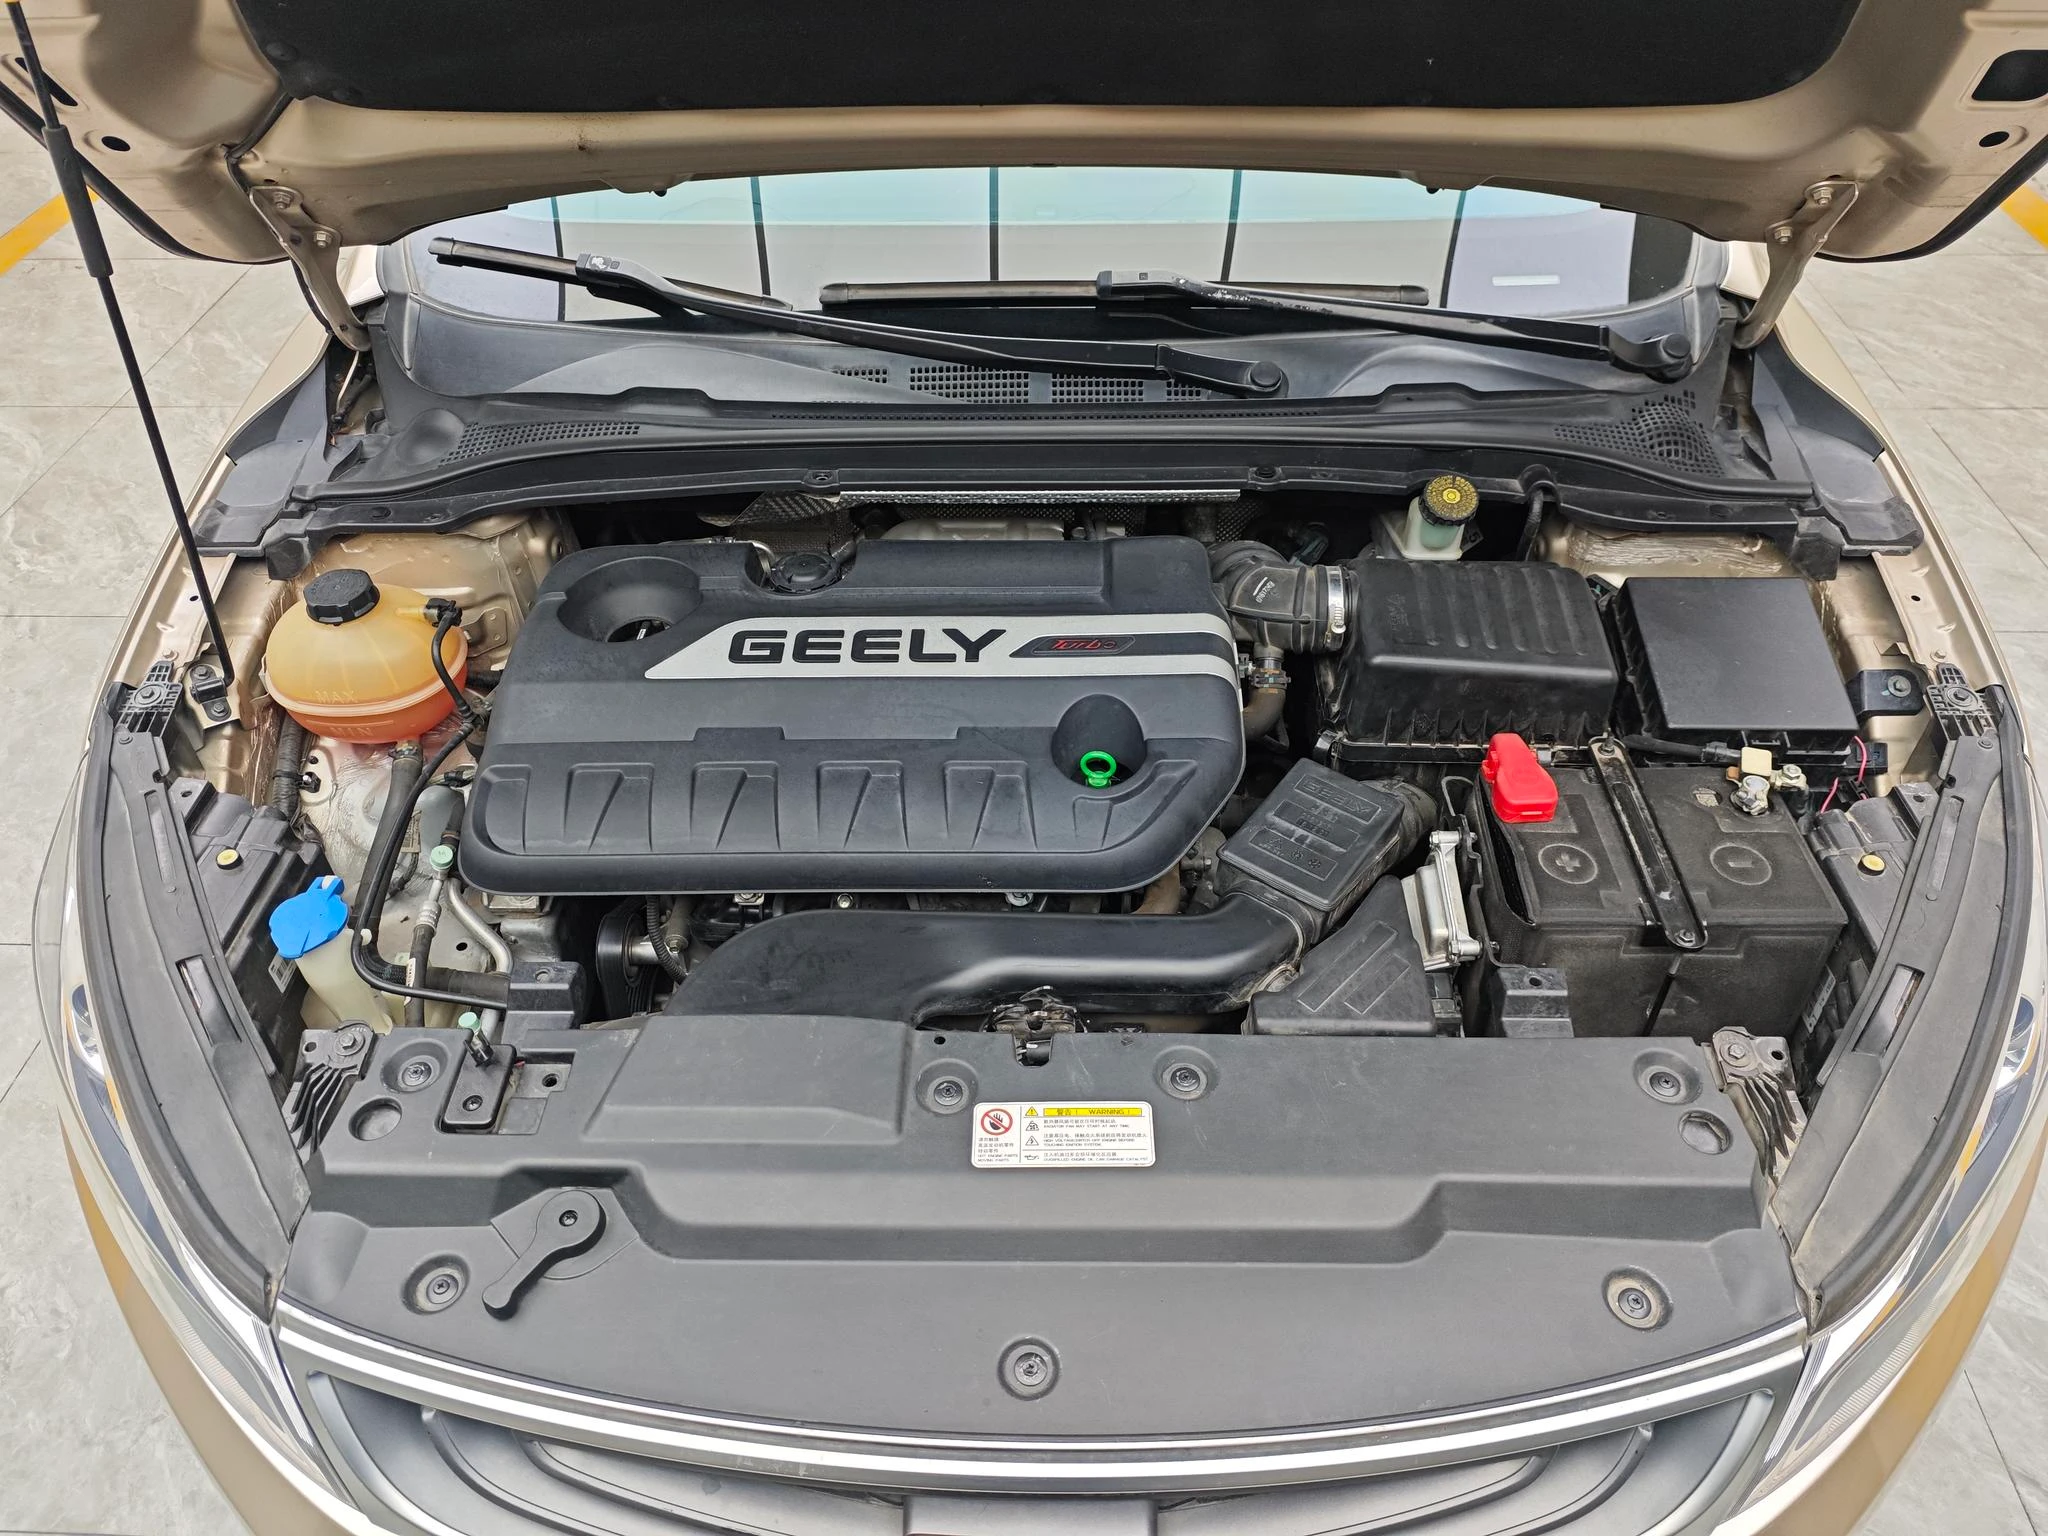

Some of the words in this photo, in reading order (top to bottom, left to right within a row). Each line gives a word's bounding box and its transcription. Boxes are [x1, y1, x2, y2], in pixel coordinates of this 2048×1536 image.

[728, 628, 1007, 664] GEELY
[1051, 639, 1116, 650] Turbo
[314, 689, 360, 704] MAX
[329, 726, 374, 737] MIN
[1302, 780, 1371, 815] GEELY
